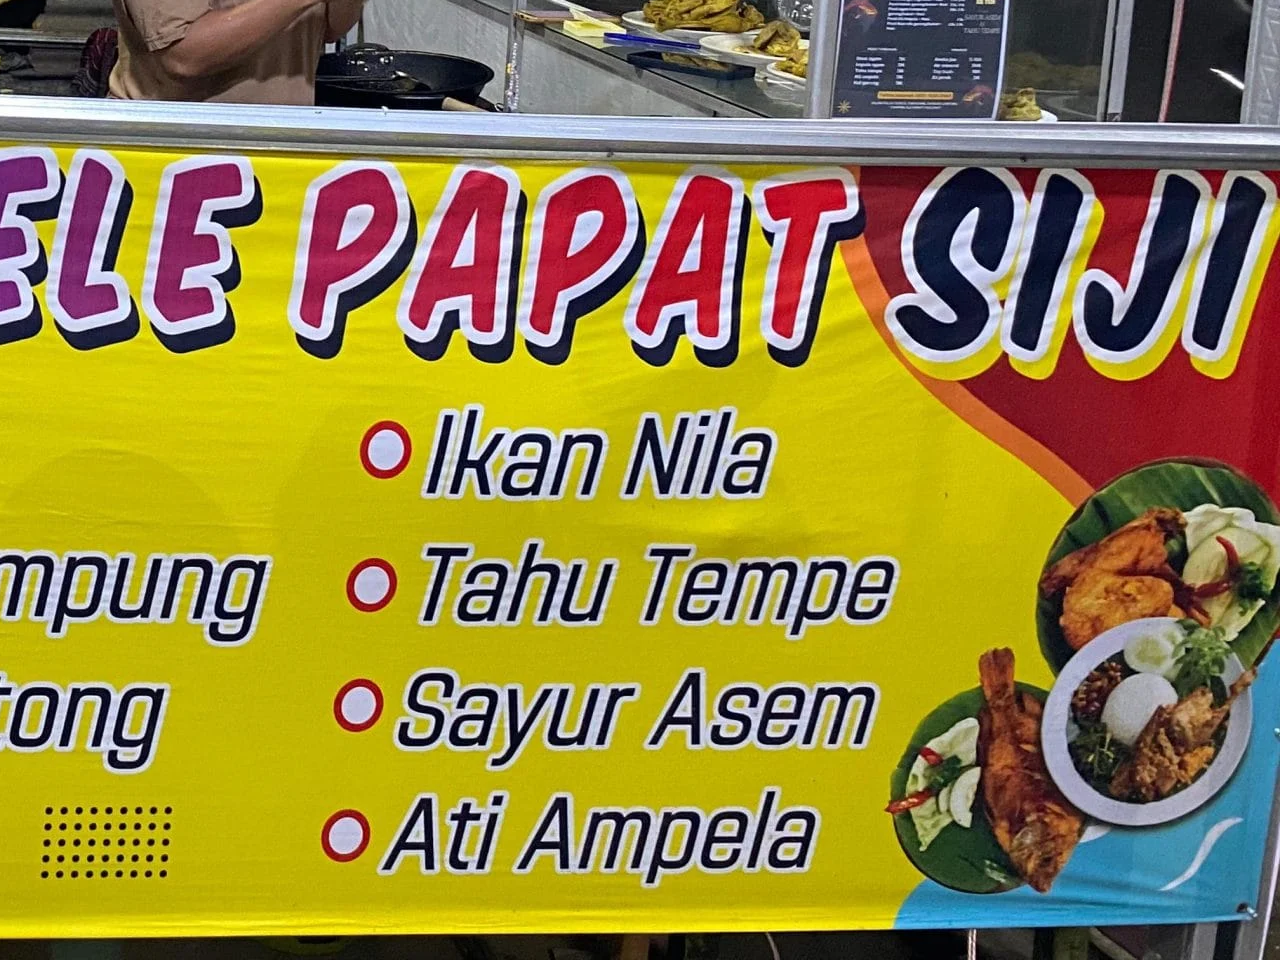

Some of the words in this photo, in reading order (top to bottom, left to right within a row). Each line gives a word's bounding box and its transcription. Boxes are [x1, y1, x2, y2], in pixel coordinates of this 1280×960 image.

[288, 159, 866, 368] PAPAT
[884, 167, 1279, 380] SIJI
[424, 407, 605, 497] Ikan
[622, 410, 774, 497] Nila
[421, 543, 616, 624] Tahu
[641, 547, 897, 637] Tempe
[397, 672, 637, 768] Sayur
[648, 673, 875, 748] Asem
[380, 794, 504, 872] Ati
[516, 791, 817, 884] Ampela
